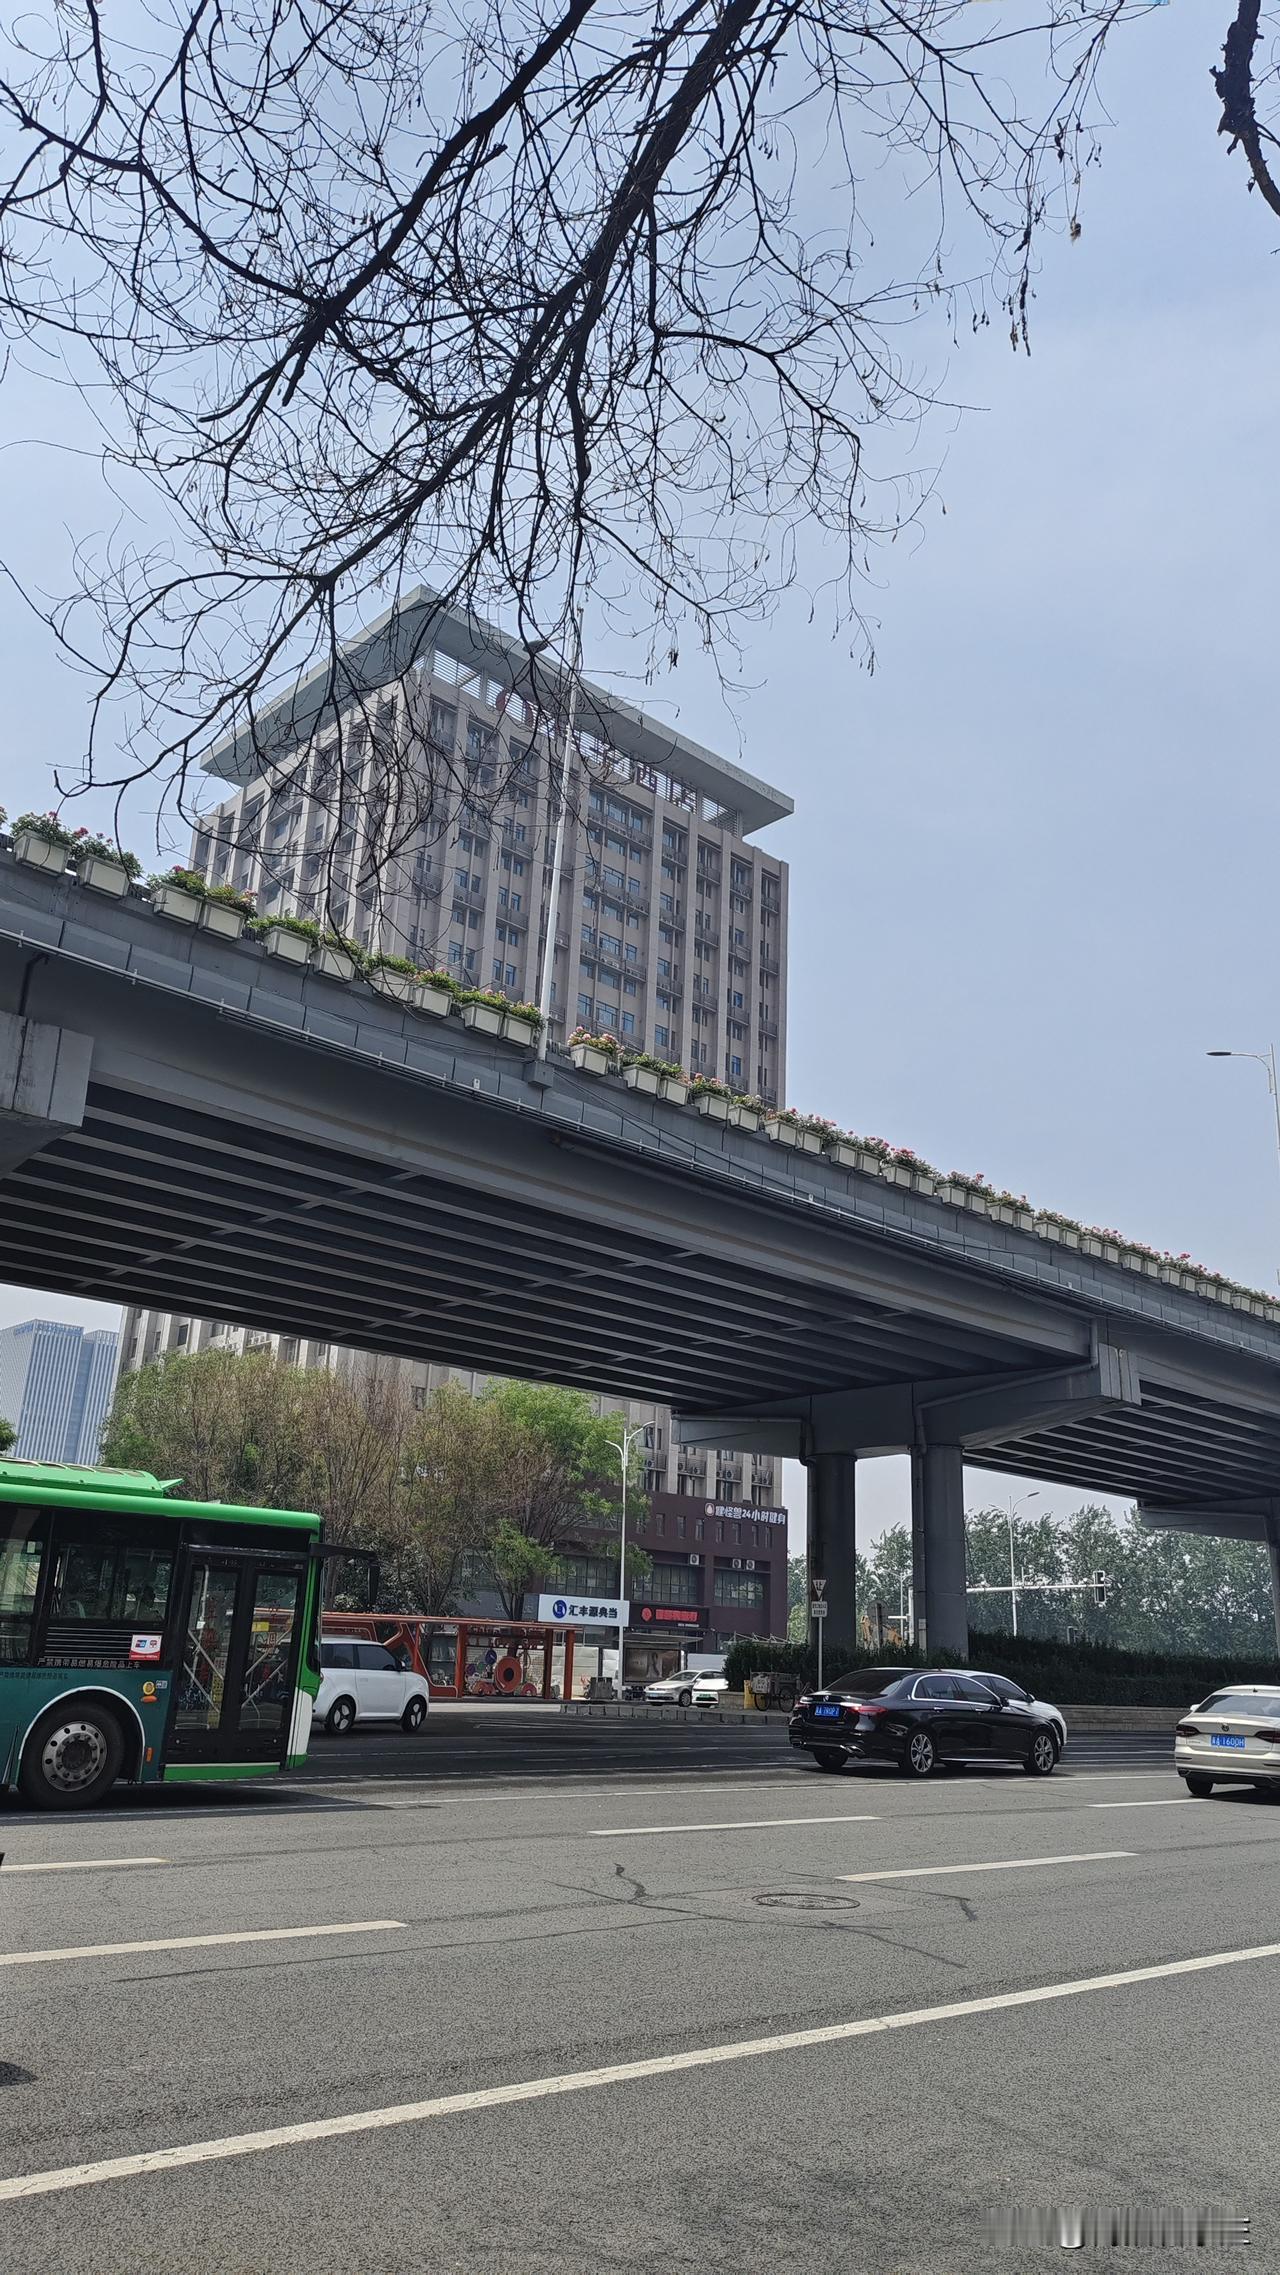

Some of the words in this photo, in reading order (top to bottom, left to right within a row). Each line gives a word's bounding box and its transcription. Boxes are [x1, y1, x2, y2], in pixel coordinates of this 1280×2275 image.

[568, 1604, 618, 1619] 汇丰源典当
